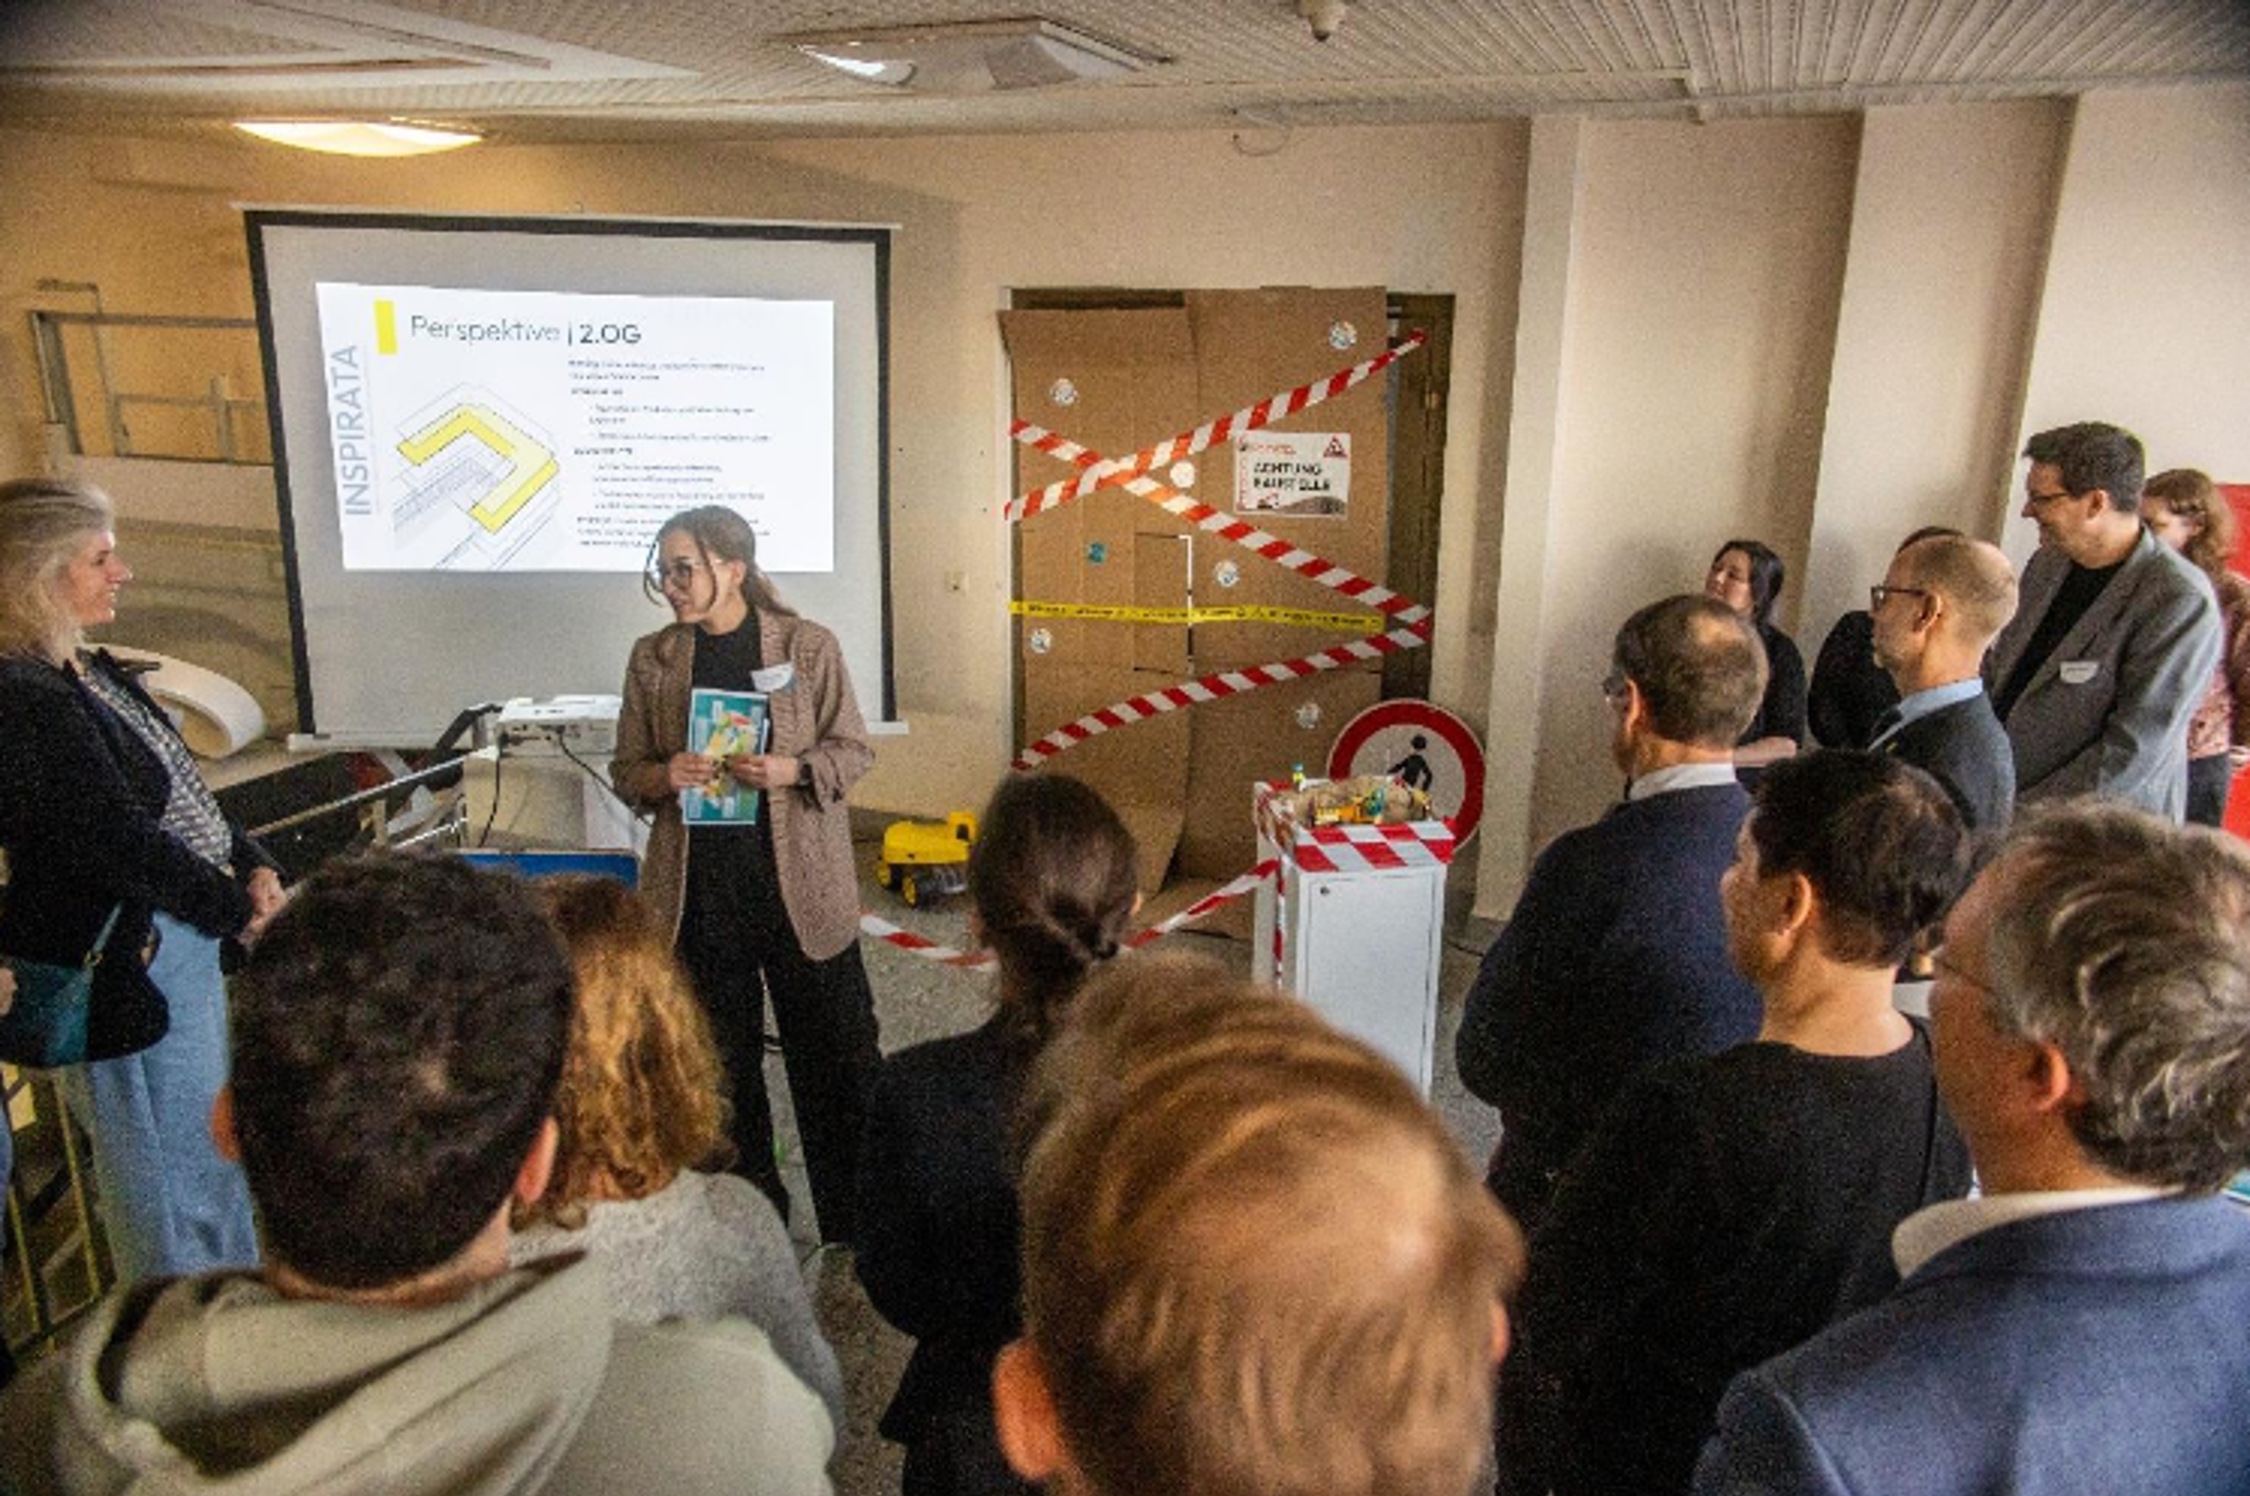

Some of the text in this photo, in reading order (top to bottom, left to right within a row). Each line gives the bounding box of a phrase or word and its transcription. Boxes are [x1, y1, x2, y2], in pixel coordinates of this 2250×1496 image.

[411, 315, 560, 345] Perspektive
[579, 323, 642, 344] 2.OG
[330, 345, 372, 516] INSPIRATA
[1253, 462, 1323, 476] ACHTUNG
